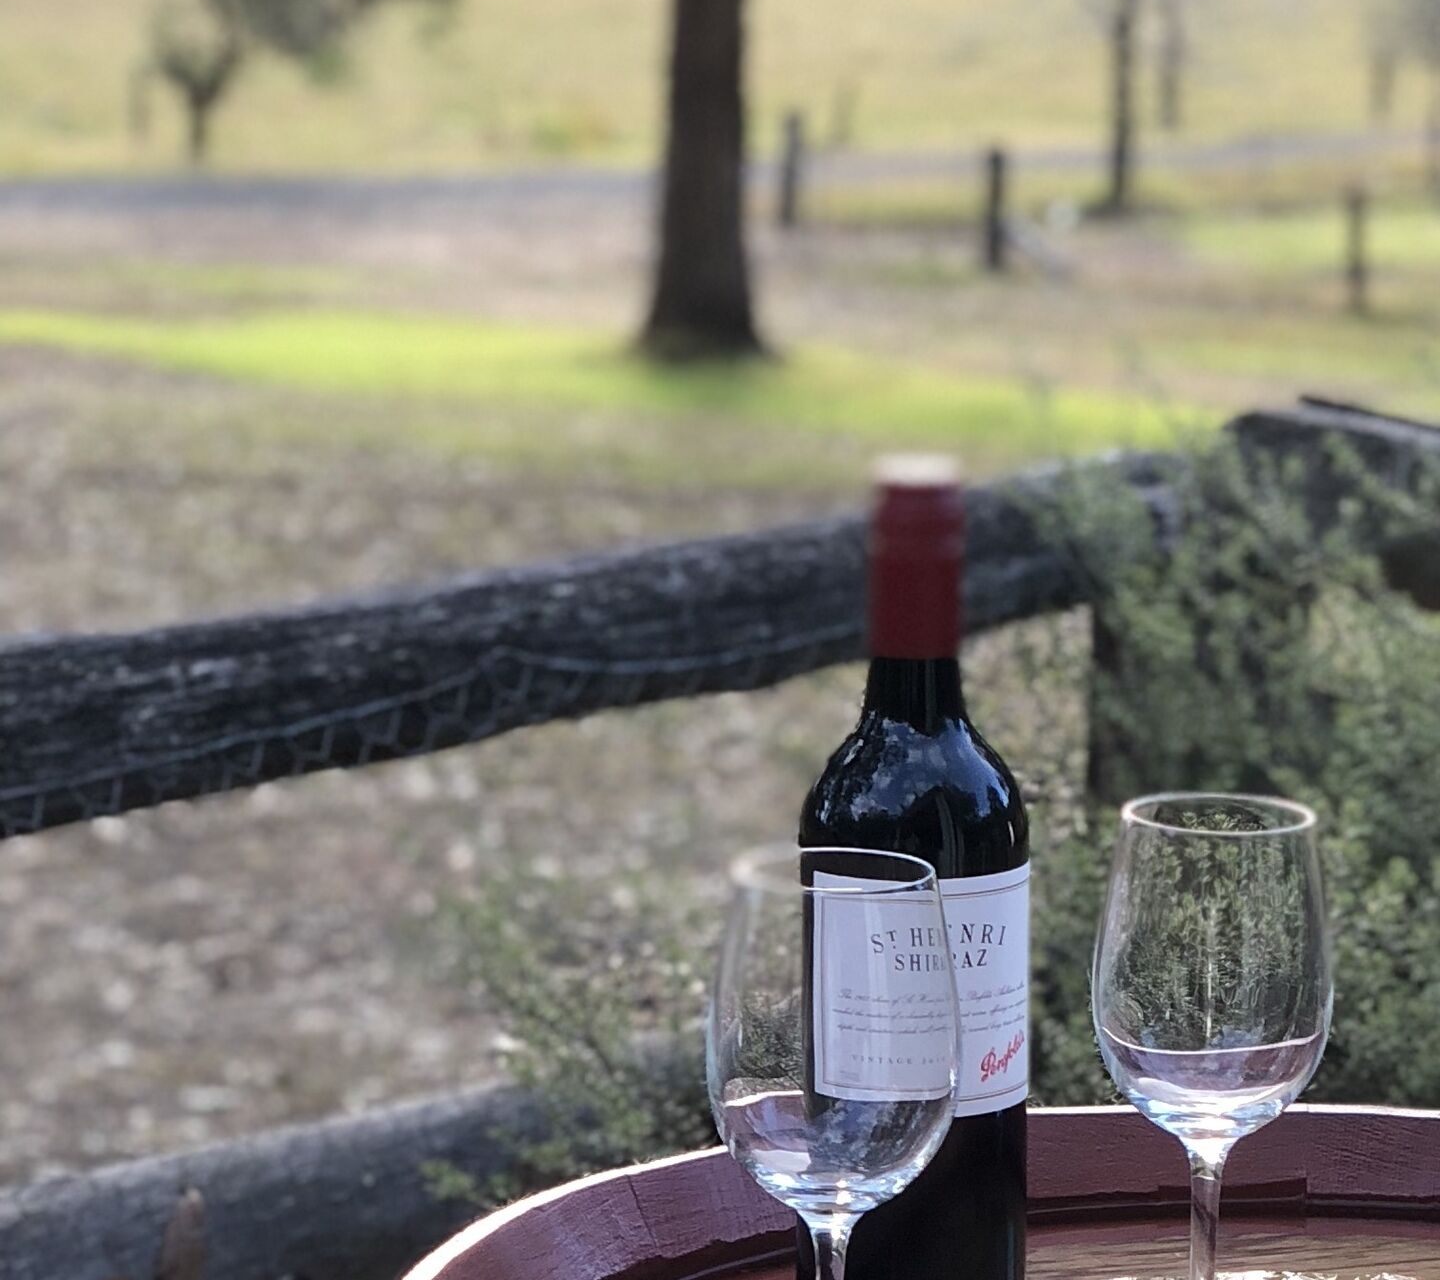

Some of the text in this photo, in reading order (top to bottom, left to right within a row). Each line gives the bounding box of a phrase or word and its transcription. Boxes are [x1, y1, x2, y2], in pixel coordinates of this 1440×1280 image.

[910, 922, 1007, 948] HENRI
[894, 948, 989, 972] SHIRAZ
[851, 1054, 913, 1065] VINTAGE
